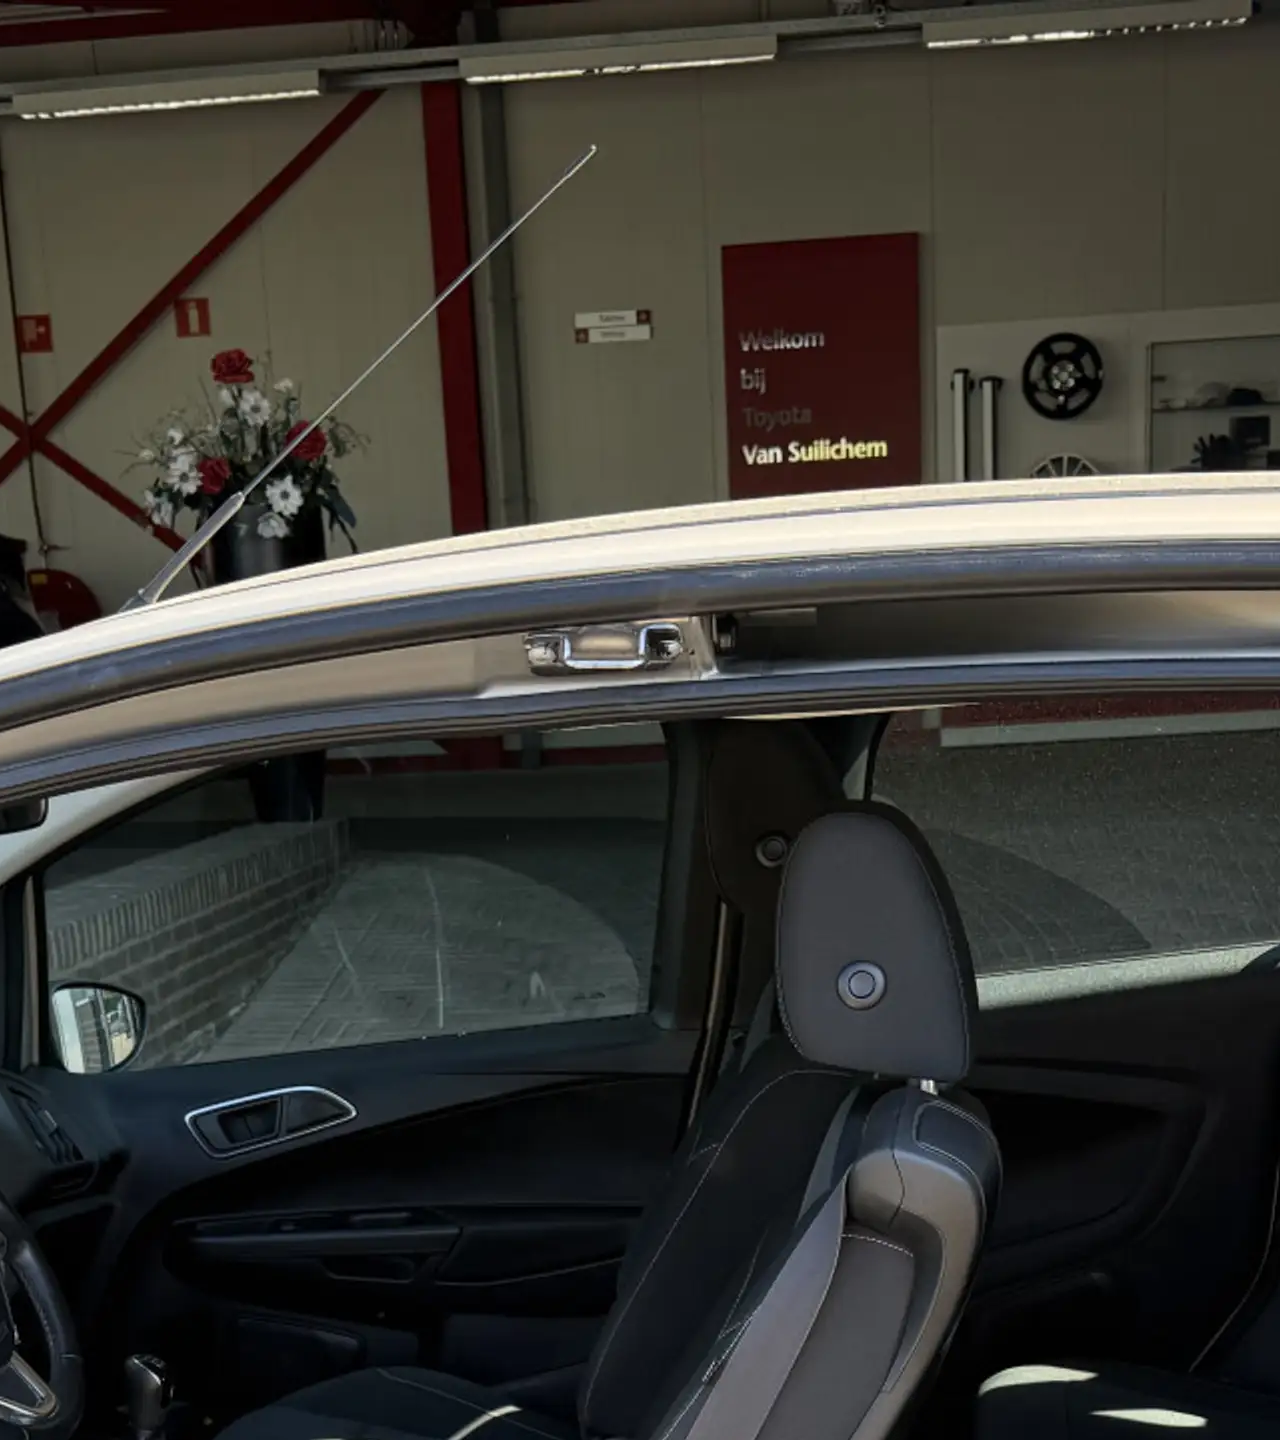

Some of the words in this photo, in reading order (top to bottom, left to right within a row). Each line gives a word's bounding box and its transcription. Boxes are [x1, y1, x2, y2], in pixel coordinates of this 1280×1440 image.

[738, 328, 825, 351] Welkom
[740, 368, 766, 394] bij
[743, 407, 812, 431] Toyota
[742, 444, 783, 465] Van
[788, 436, 888, 462] Suilichem
